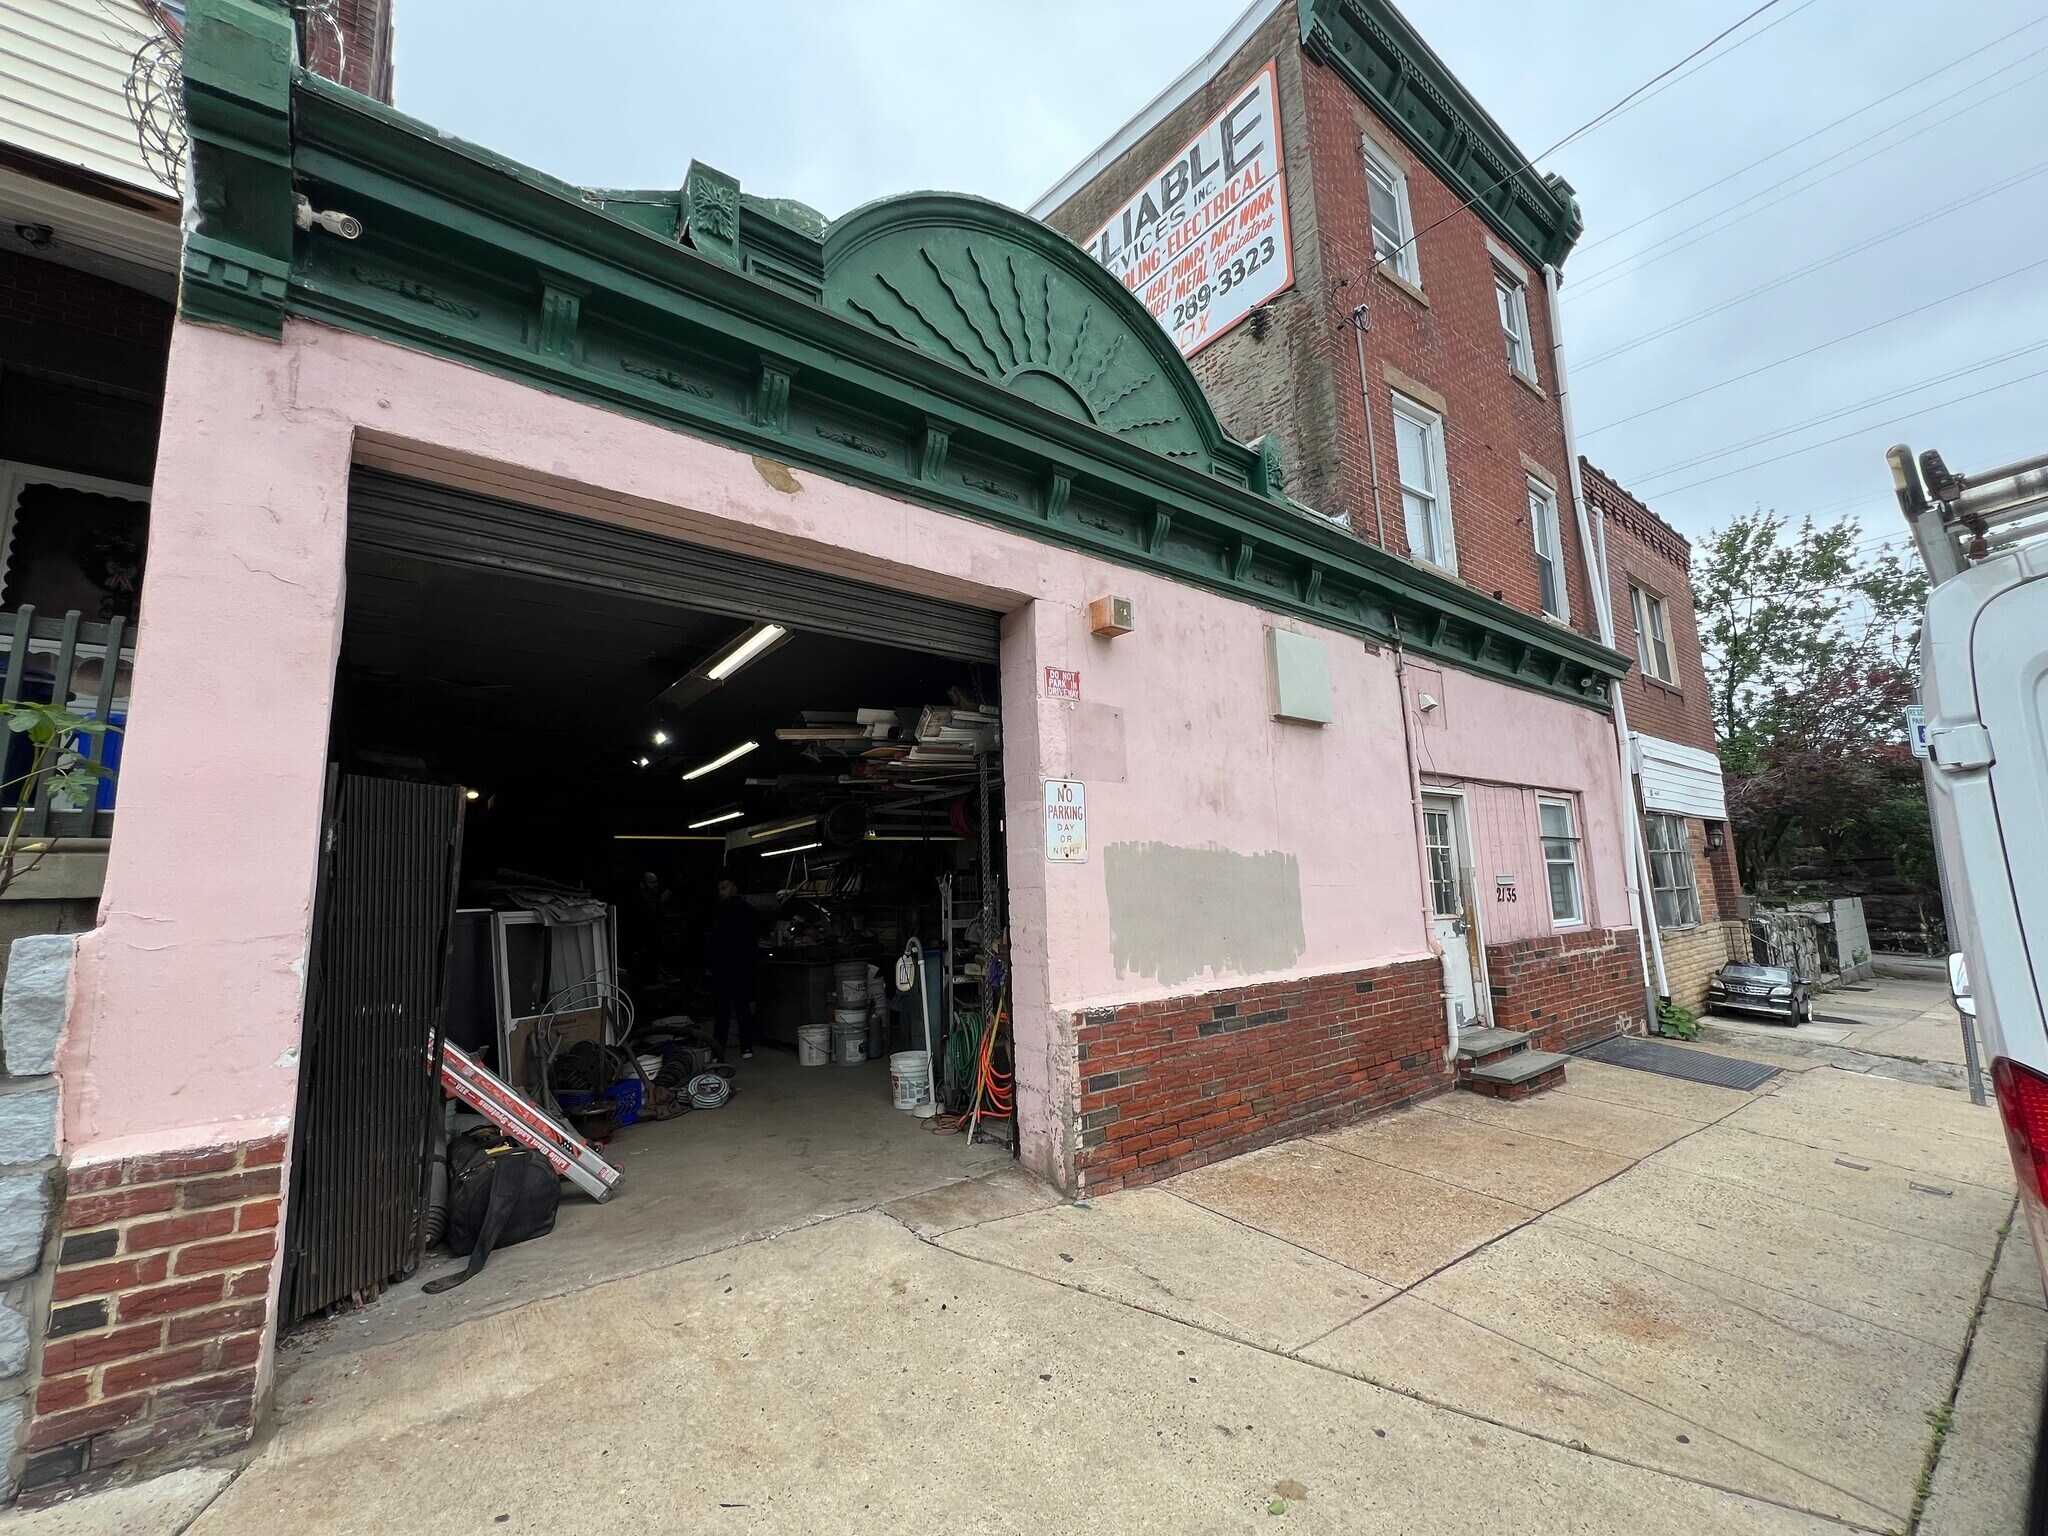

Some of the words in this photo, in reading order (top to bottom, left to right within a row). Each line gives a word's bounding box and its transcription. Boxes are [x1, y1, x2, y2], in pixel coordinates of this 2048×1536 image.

[1193, 180, 1217, 207] INC.
[1144, 272, 1168, 305] HEAT
[1171, 240, 1207, 285] PUMPS
[1210, 215, 1237, 254] DUCT
[1239, 183, 1275, 230] WORK
[1147, 288, 1172, 318] HEET
[1174, 260, 1208, 303] METAL
[1212, 213, 1275, 277] Fabricators
[1173, 236, 1275, 332] 289-3323
[1050, 670, 1059, 679] DO
[1062, 671, 1075, 681] NOT
[1047, 686, 1079, 698] DRIVEWAY
[1049, 678, 1067, 688] PARK
[1070, 681, 1077, 690] IN
[1057, 787, 1073, 803] NO
[1048, 804, 1083, 821] PARKING
[1057, 823, 1074, 831] DAY
[1060, 834, 1072, 842] OR
[1053, 846, 1081, 855] NIGHT
[1496, 887, 1517, 903] 2135
